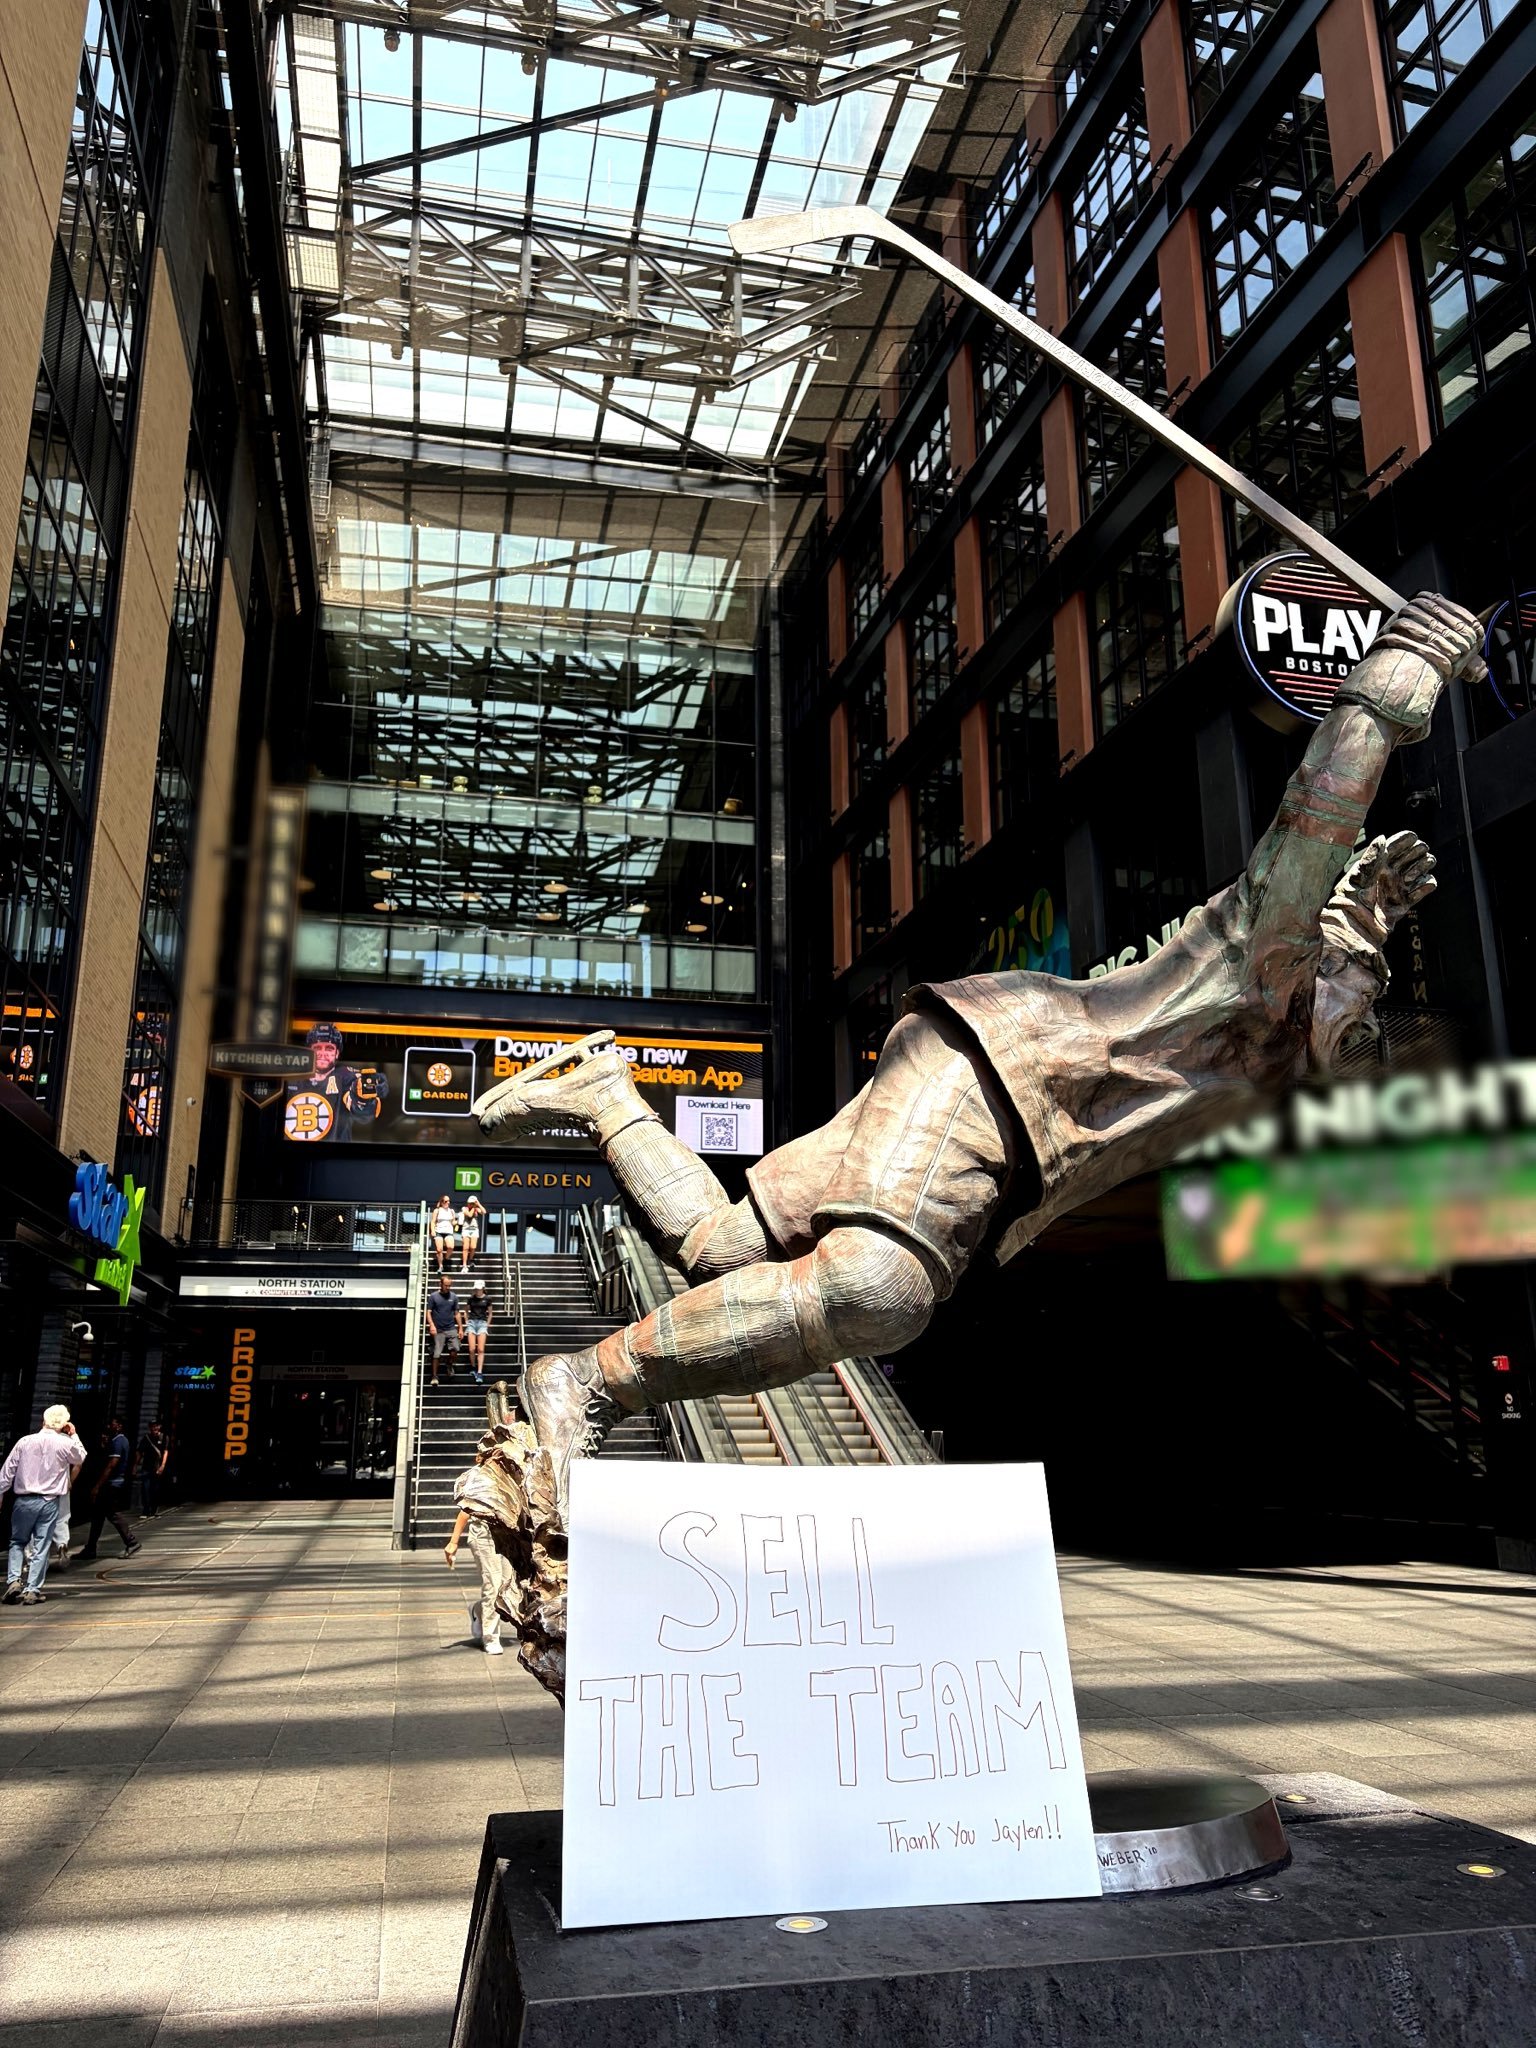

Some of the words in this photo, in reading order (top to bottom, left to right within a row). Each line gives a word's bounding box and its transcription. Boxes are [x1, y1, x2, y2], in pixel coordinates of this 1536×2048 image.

[1251, 592, 1382, 661] PLAY
[1286, 656, 1357, 678] BOSTO
[215, 1051, 271, 1065] KITCHEN
[274, 1053, 283, 1065] &
[285, 1055, 310, 1067] TAP
[643, 1047, 688, 1065] new
[627, 1063, 697, 1086] Garden
[701, 1066, 744, 1091] App
[422, 1090, 469, 1100] GARDEN
[687, 1099, 728, 1110] Download
[730, 1102, 752, 1111] Here
[457, 1170, 481, 1187] TD
[488, 1171, 592, 1188] GARDEN
[258, 1279, 297, 1288] NORTH
[300, 1279, 345, 1289] STATION
[175, 1366, 202, 1376] star
[658, 1511, 894, 1652] SELL
[579, 1673, 759, 1806] THE
[810, 1651, 1067, 1787] TEAM
[949, 1822, 976, 1848] You
[991, 1805, 1062, 1851] Jaylen!!
[1097, 1849, 1145, 1867] WEBER
